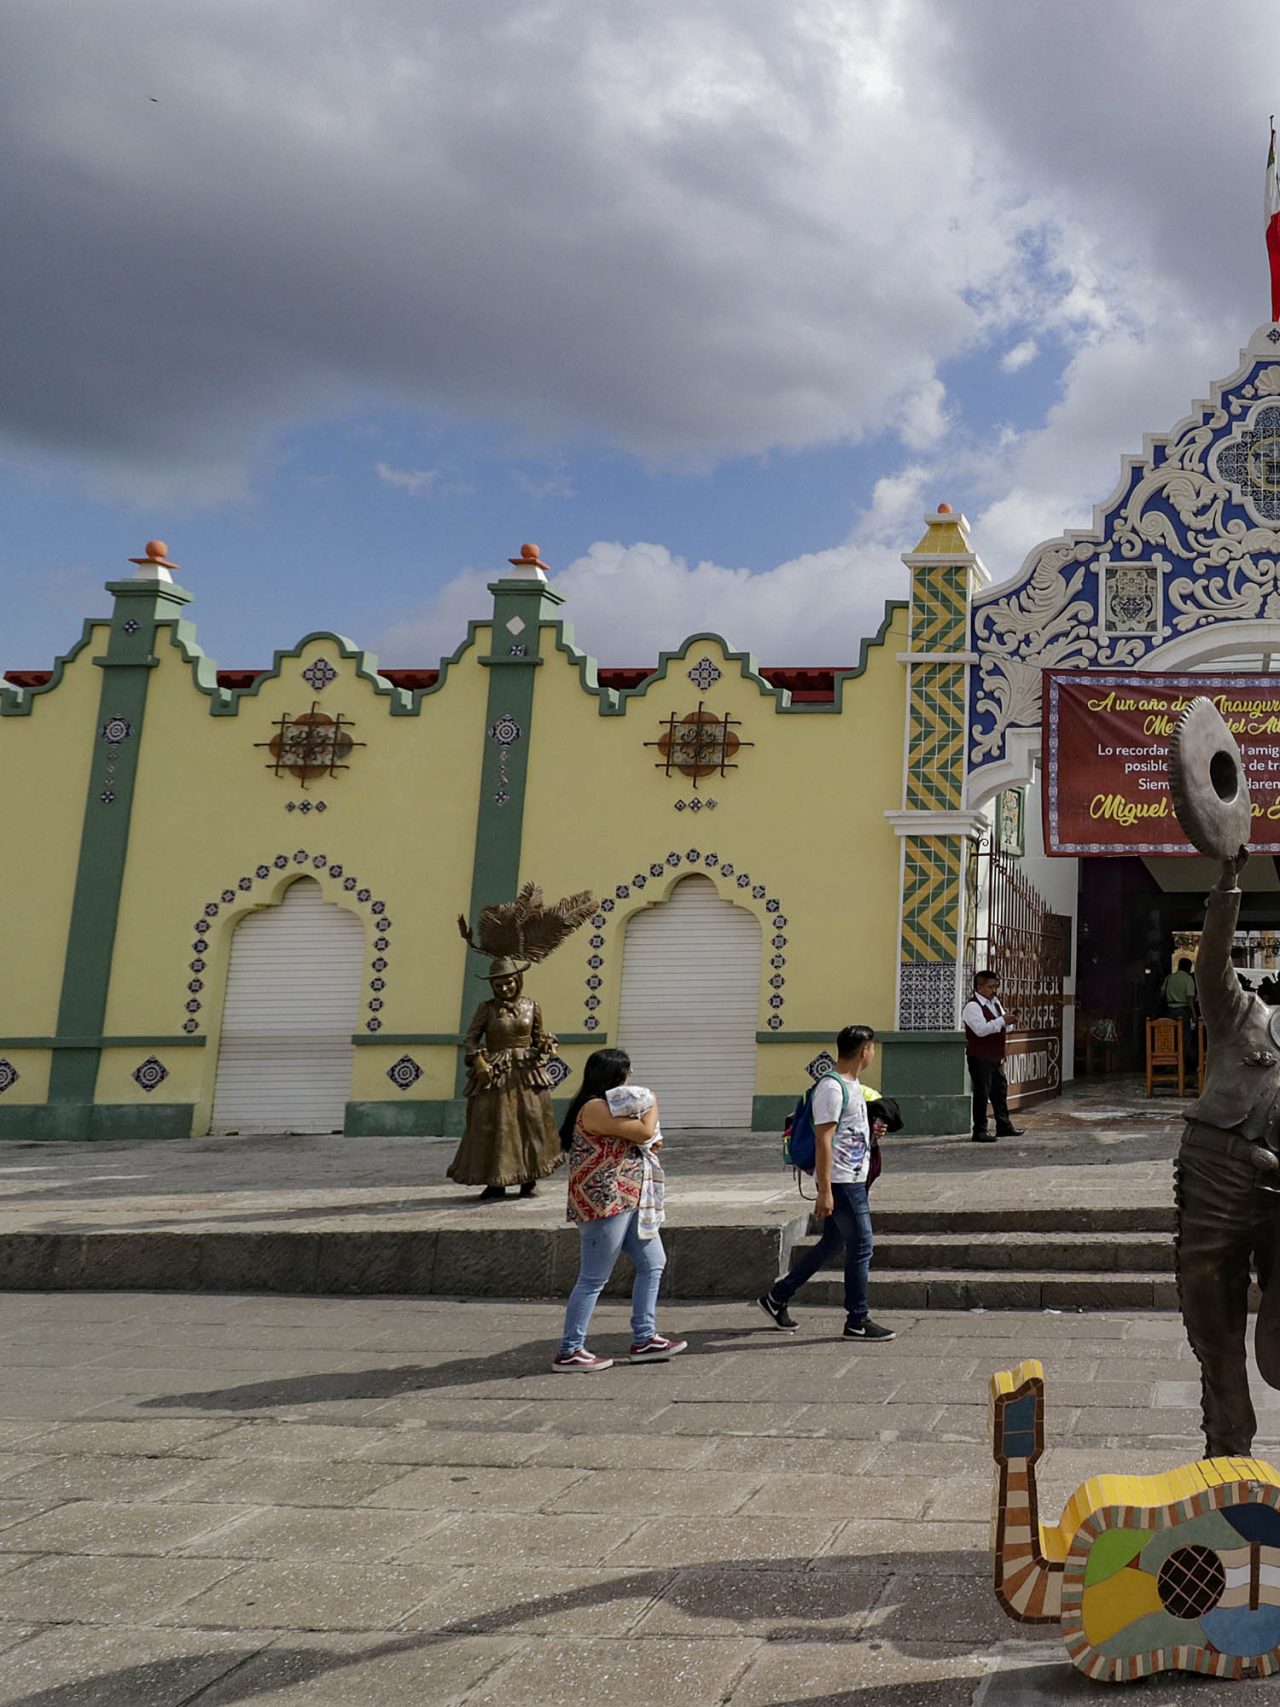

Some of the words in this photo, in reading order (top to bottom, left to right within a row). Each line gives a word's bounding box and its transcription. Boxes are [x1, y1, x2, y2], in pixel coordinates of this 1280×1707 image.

[1087, 691, 1115, 712] A
[1115, 699, 1137, 711] un
[1138, 698, 1168, 711] año
[1098, 744, 1113, 756] Lo
[1125, 760, 1168, 774] posible
[1249, 759, 1265, 771] de
[1090, 793, 1168, 826] Miguel
